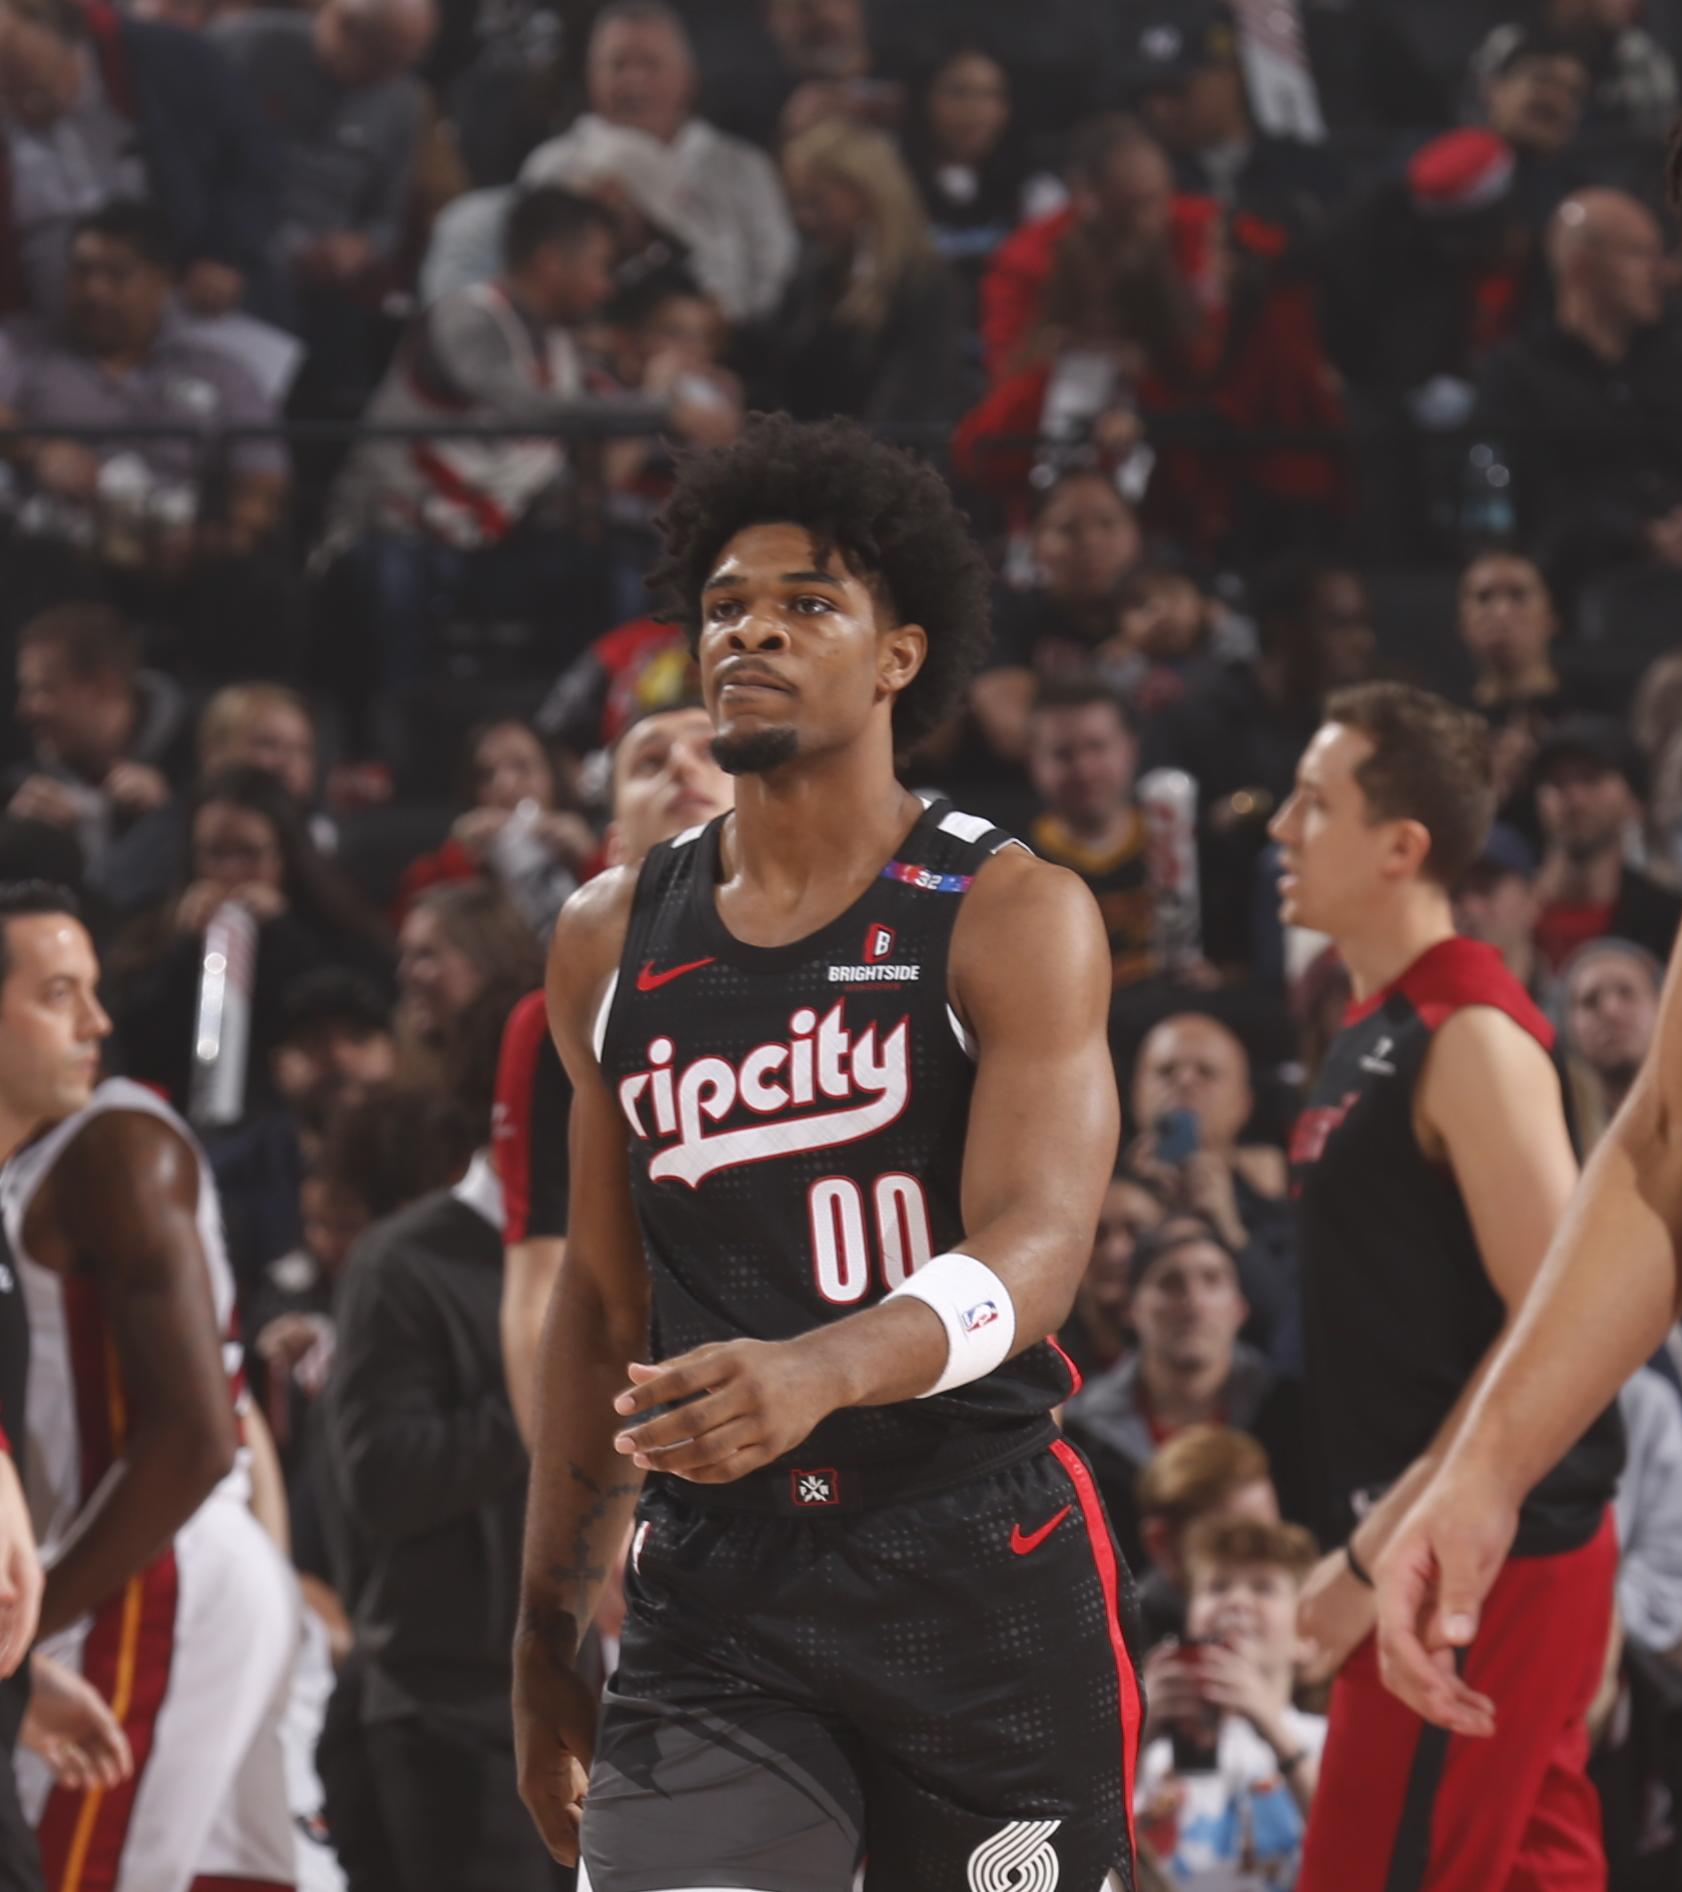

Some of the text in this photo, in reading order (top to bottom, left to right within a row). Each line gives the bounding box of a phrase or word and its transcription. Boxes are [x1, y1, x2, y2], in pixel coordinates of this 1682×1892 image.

[915, 869, 943, 890] 32
[874, 930, 891, 956] B
[828, 965, 921, 982] BRIGHTSIDE
[619, 996, 911, 1191] ripcity
[807, 1170, 935, 1304] 00
